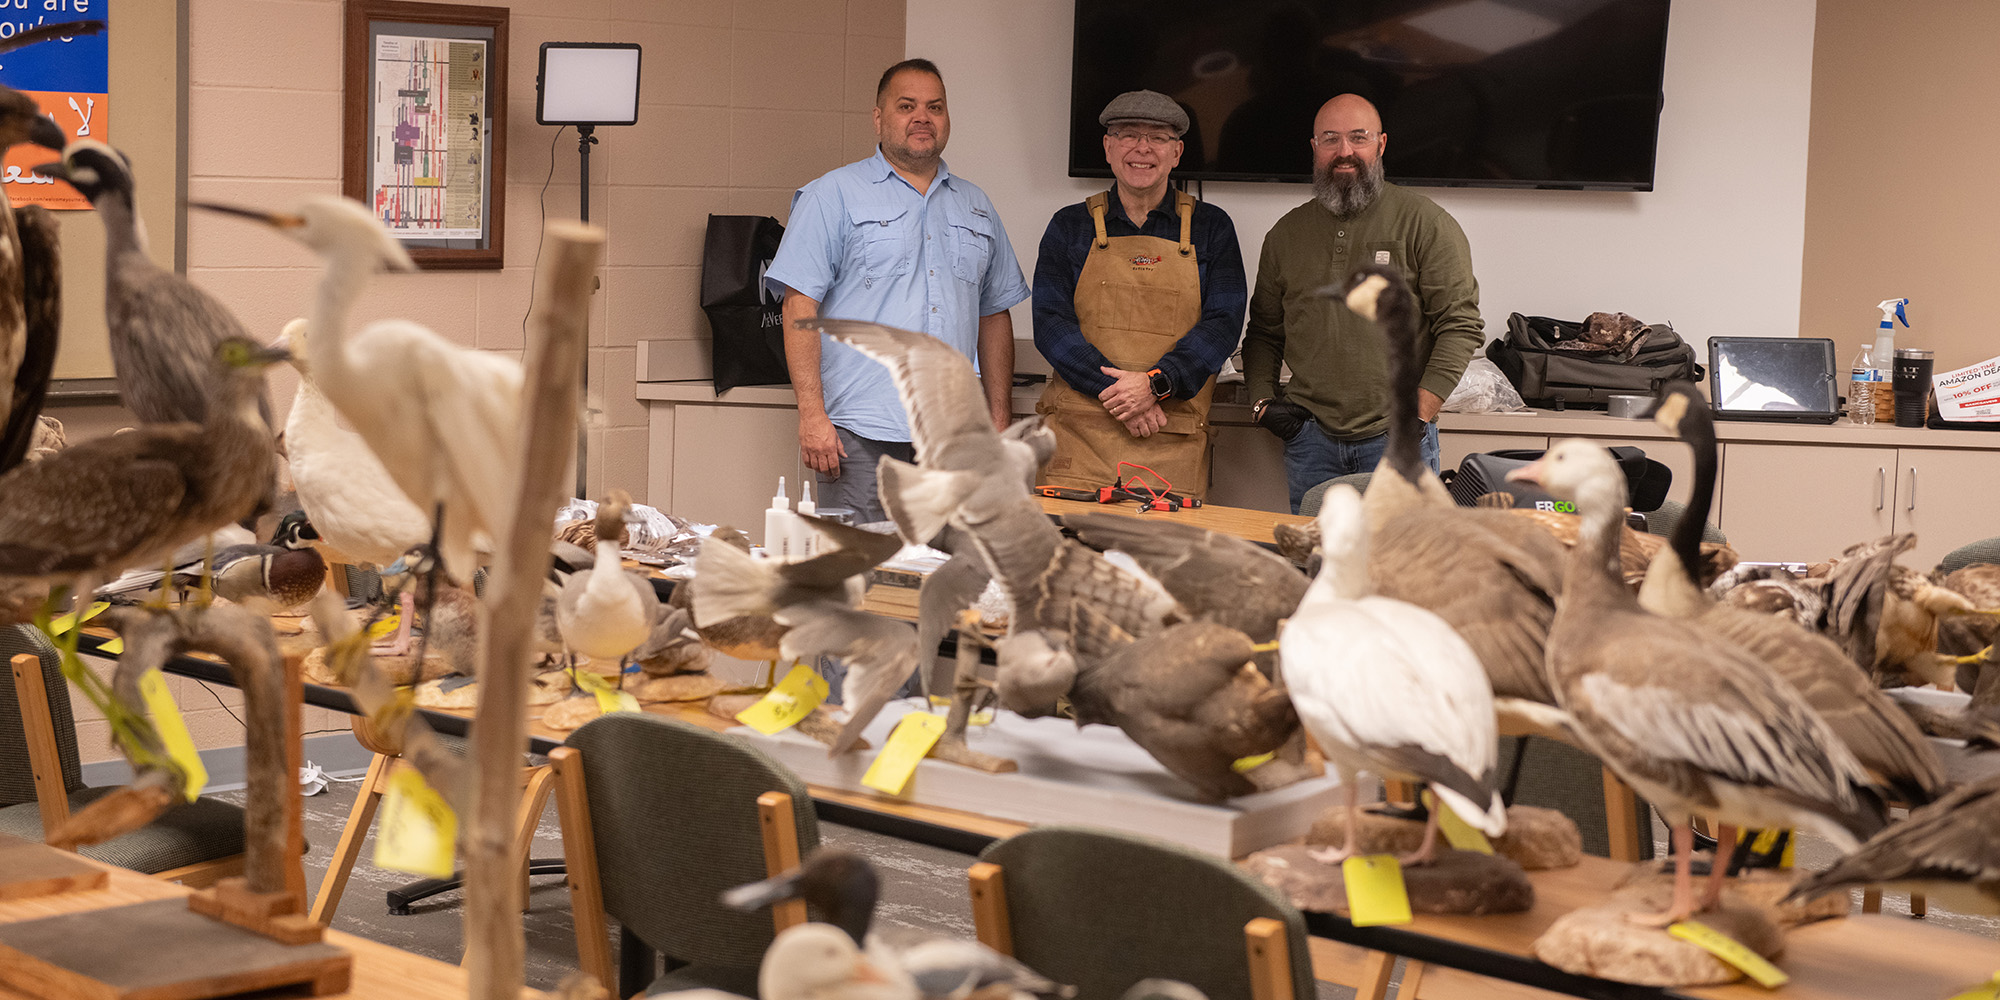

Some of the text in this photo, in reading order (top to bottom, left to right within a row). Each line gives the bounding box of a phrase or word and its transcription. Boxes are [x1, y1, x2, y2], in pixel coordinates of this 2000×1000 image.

[43, 0, 89, 13] are
[1939, 372, 1982, 387] AMAZON
[1952, 390, 1972, 399] 10%
[1973, 383, 1992, 393] OFF
[1535, 501, 1576, 513] ERGO
